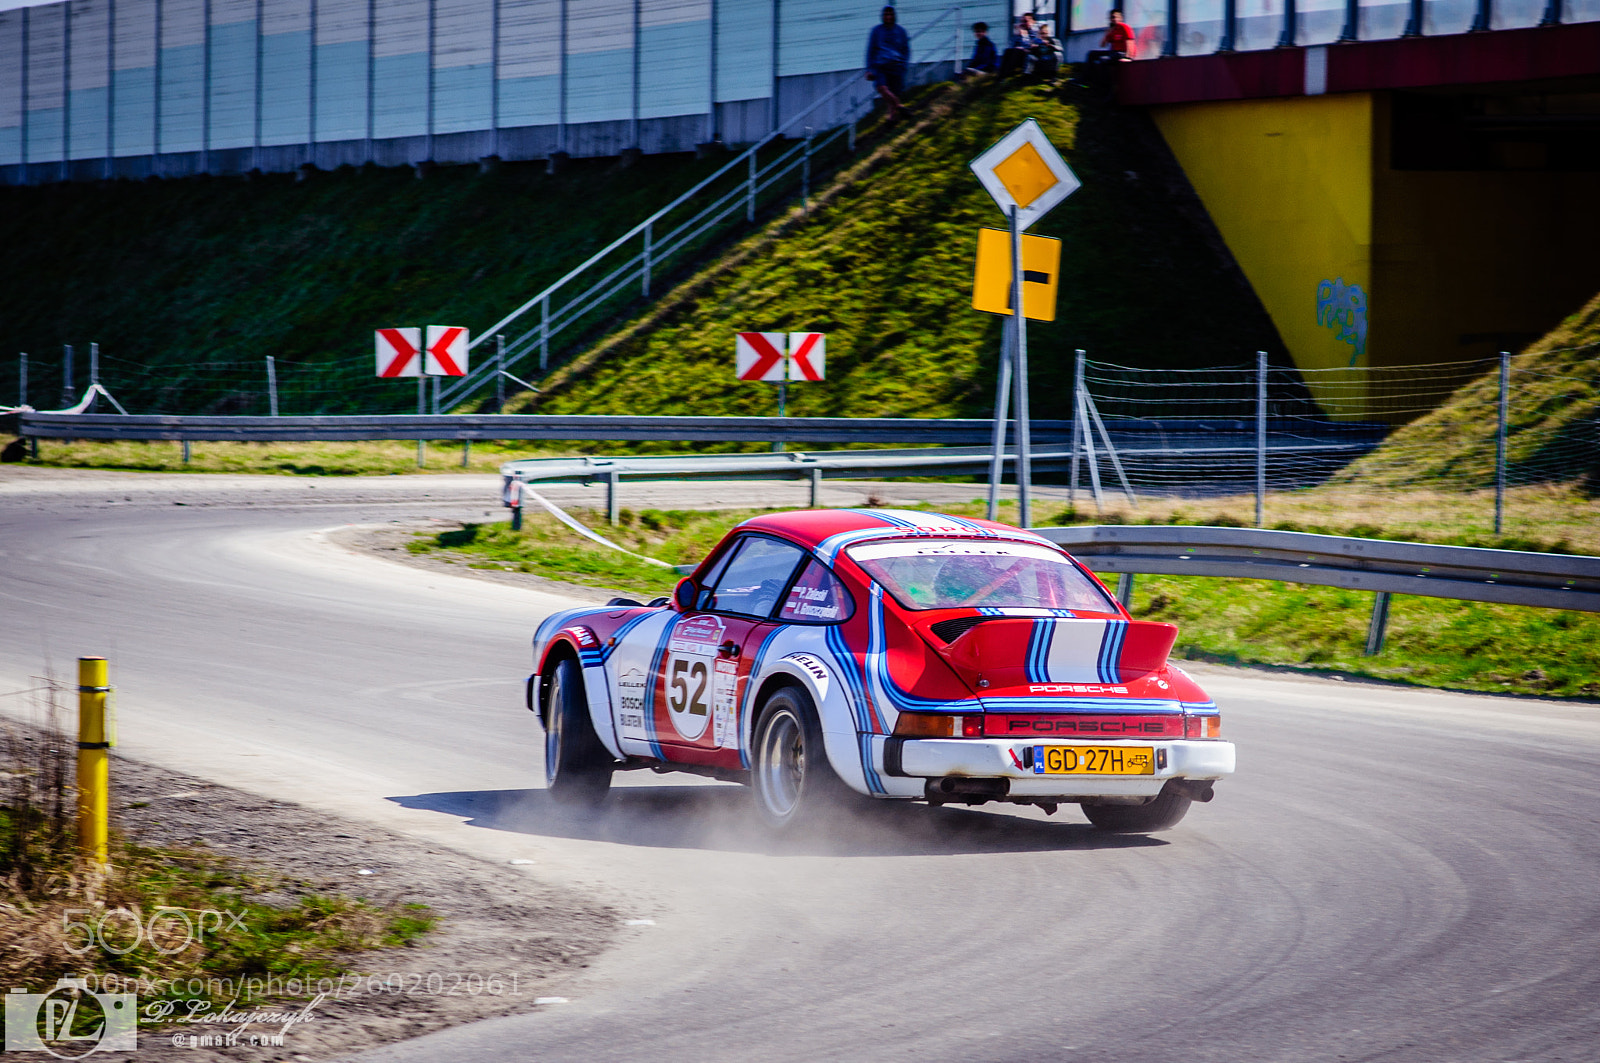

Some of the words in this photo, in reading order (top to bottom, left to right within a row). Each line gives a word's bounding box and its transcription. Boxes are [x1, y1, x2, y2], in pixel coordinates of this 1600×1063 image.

[670, 659, 707, 716] 52
[1029, 685, 1128, 694] PORSCHE
[1009, 720, 1164, 733] PORSCHE
[1048, 748, 1078, 771] GD
[1086, 749, 1124, 772] 27H
